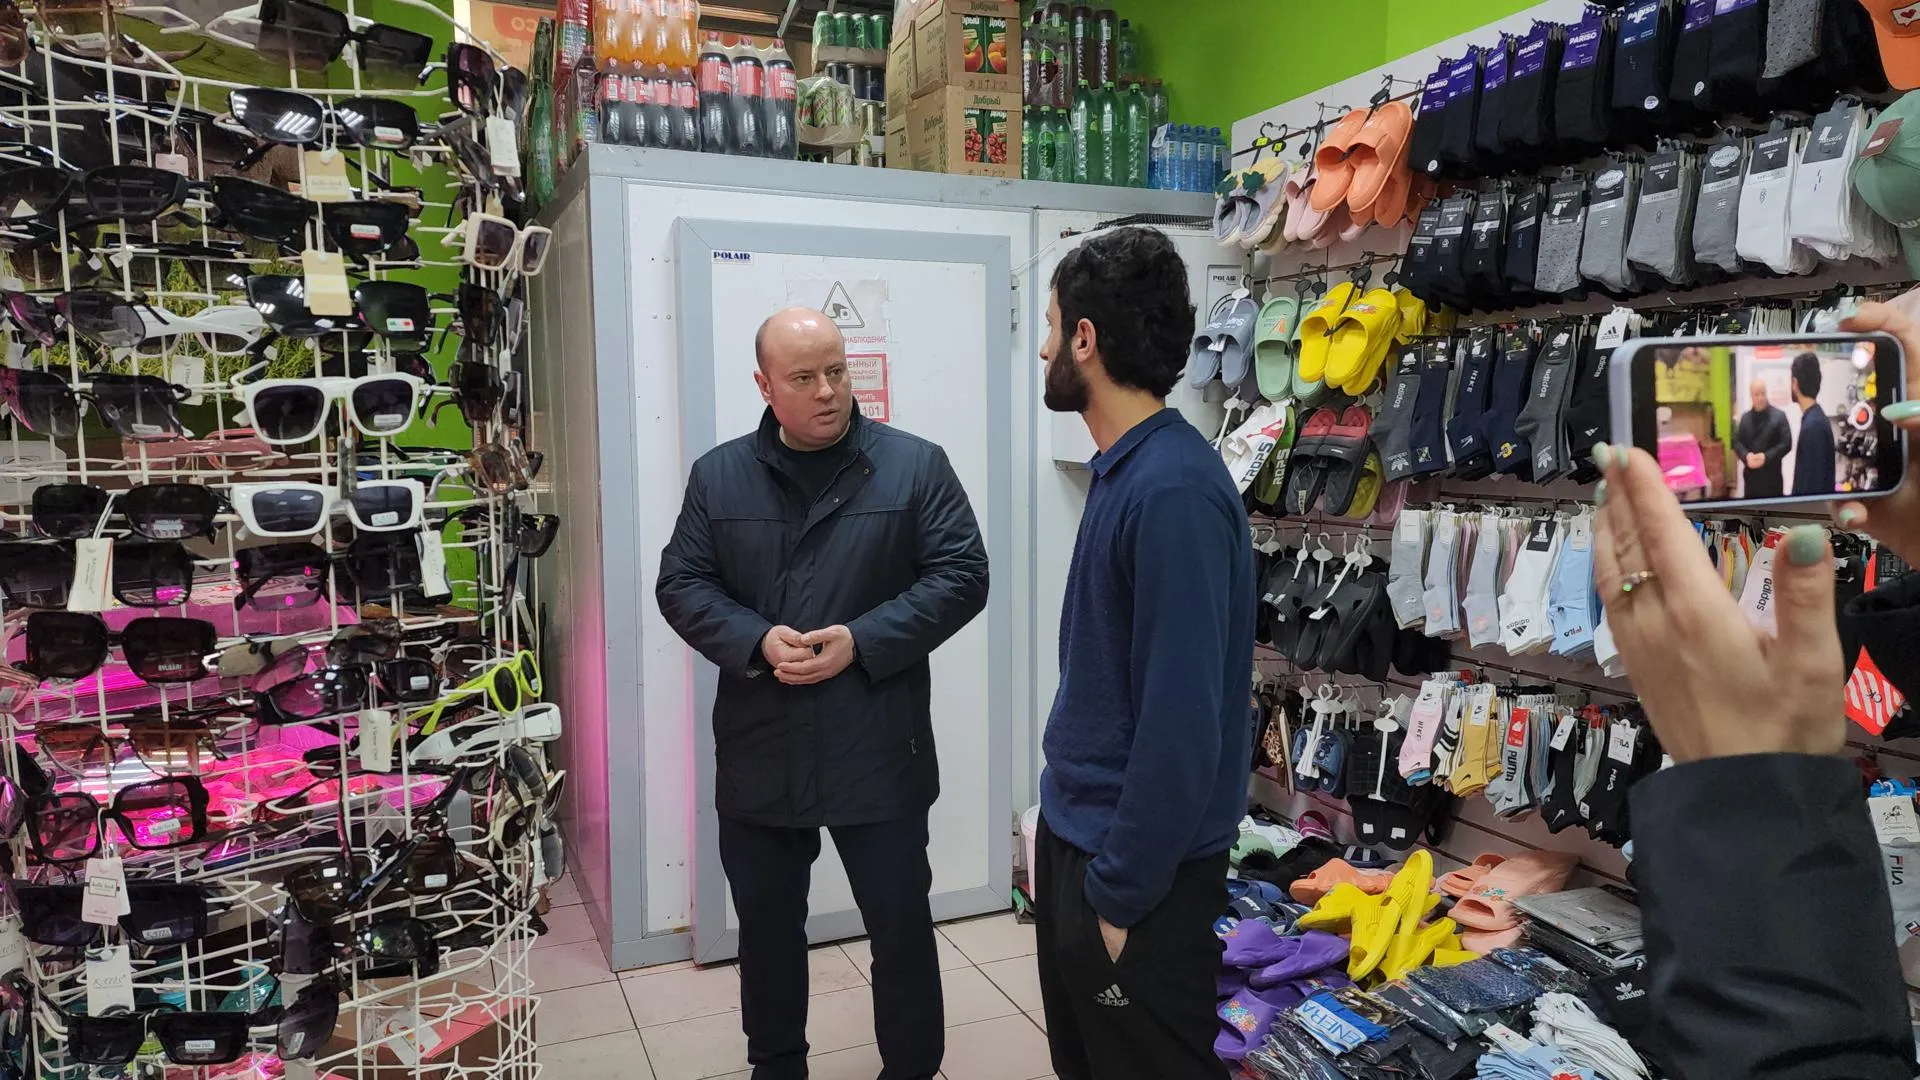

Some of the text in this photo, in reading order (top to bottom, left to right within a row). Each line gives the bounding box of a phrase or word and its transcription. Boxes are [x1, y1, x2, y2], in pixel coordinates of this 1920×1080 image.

[1569, 31, 1597, 45] PARISO
[1518, 40, 1544, 56] PARISO
[1486, 52, 1504, 68] PARISO
[1450, 62, 1473, 77] PARISO
[1426, 79, 1448, 90] PARISO
[973, 94, 1001, 106] Добрый
[1758, 136, 1788, 149] ROSSELA
[1650, 160, 1677, 172] ROSSELA
[713, 252, 751, 260] POLAIR
[842, 336, 887, 344] НАБЛЮДЕНИЕ
[848, 360, 878, 368] ЕННЫЙ
[1466, 370, 1479, 392] NIKE
[1540, 368, 1552, 398] adidas
[1393, 382, 1406, 408] adidas
[863, 406, 880, 416] 101
[1240, 442, 1273, 483] TROPS
[1756, 577, 1773, 612] adidas
[1506, 618, 1530, 630] adidas
[1505, 750, 1518, 782] PUMA
[1606, 768, 1618, 792] FILA
[1890, 855, 1904, 886] FILA
[1616, 988, 1646, 1000] adidas
